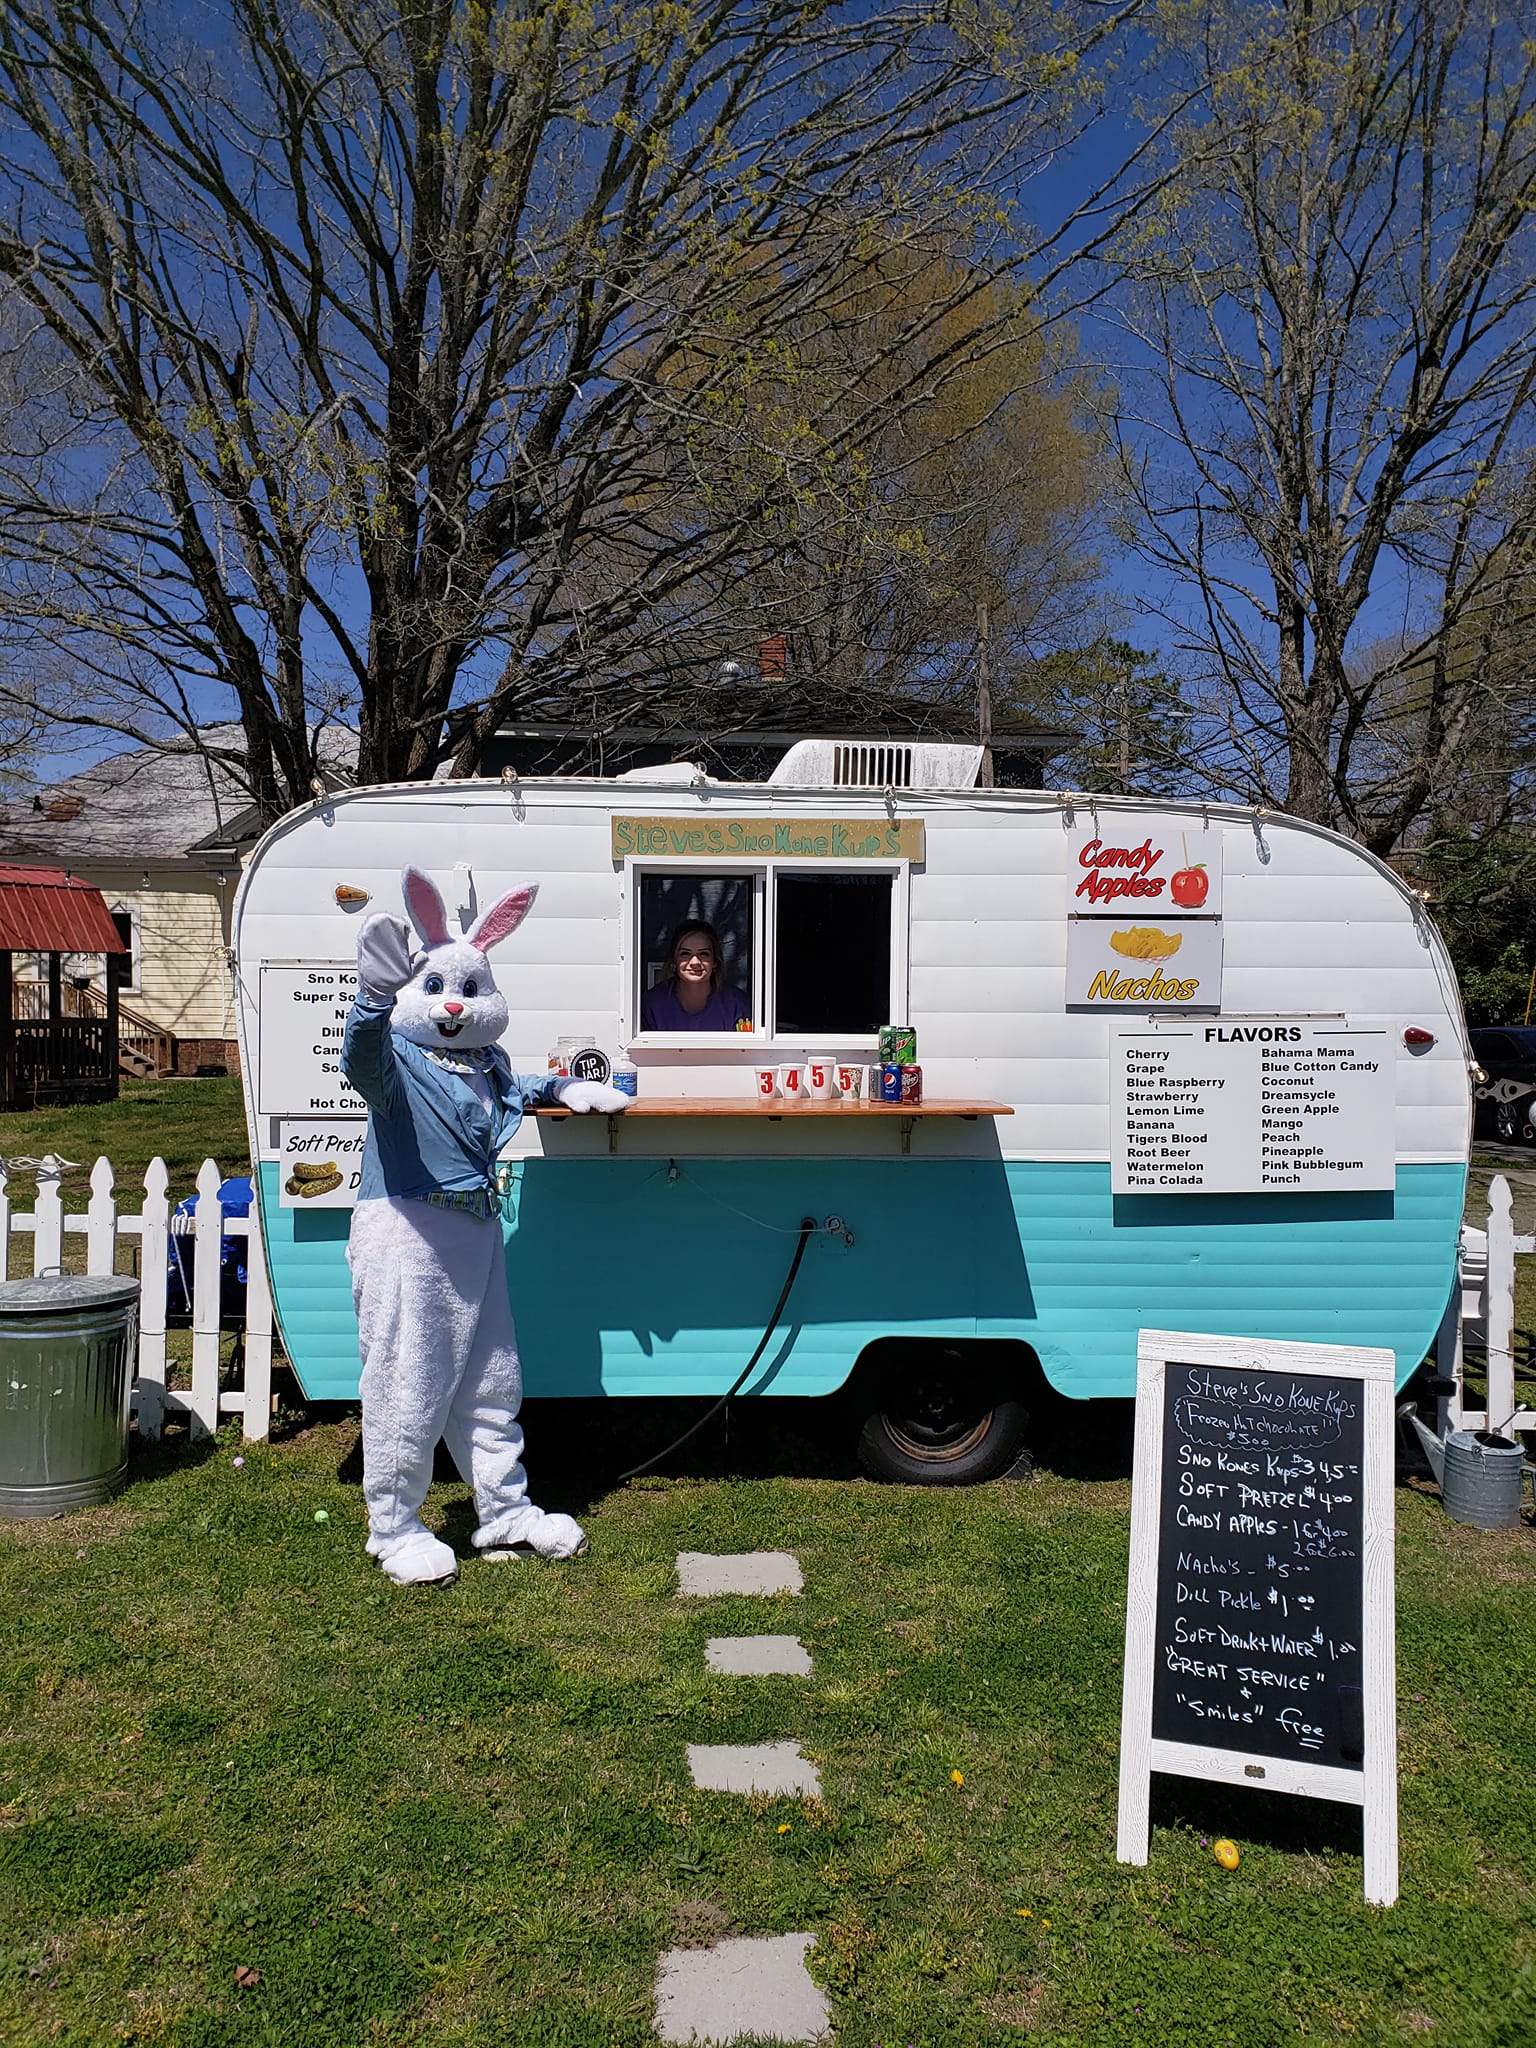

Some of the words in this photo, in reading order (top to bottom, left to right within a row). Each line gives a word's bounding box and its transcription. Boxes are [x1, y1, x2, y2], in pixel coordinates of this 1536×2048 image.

[615, 821, 725, 855] Steve's
[1078, 838, 1164, 875] Candy
[1075, 869, 1166, 905] Apples
[308, 974, 334, 984] Sno
[339, 974, 358, 984] Ko
[1087, 967, 1199, 1001] Nachos
[293, 991, 335, 1003] Super
[338, 992, 356, 1002] So
[322, 1027, 344, 1037] Dill
[1205, 1027, 1302, 1043] FLAVORS
[1127, 1050, 1170, 1061] Cherry
[1262, 1048, 1313, 1058] Bahama
[1317, 1047, 1355, 1057] Mama
[579, 1058, 597, 1071] TIP
[1127, 1064, 1165, 1075] Grape
[1262, 1062, 1290, 1072] Blue
[1294, 1062, 1336, 1072] Cotton
[1340, 1061, 1379, 1073] Candy
[582, 1066, 605, 1081] JAR!
[812, 1065, 824, 1088] 5
[761, 1072, 773, 1094] 3
[786, 1069, 799, 1092] 4
[839, 1069, 851, 1091] 5
[1127, 1078, 1155, 1088] Blue
[1159, 1078, 1226, 1089] Raspberry
[1262, 1076, 1315, 1086] Coconut
[1127, 1092, 1199, 1103] Strawberry
[1262, 1090, 1336, 1101] Dreamsycle
[310, 1098, 335, 1109] Hot
[340, 1098, 366, 1109] Cho
[1127, 1106, 1169, 1116] Lemon
[1173, 1106, 1205, 1116] Lime
[1262, 1105, 1299, 1114] Green
[1303, 1104, 1340, 1115] Apple
[1127, 1120, 1175, 1130] Banana
[1262, 1119, 1303, 1130] Mango
[1127, 1134, 1167, 1145] Tigers
[1171, 1134, 1208, 1144] Blood
[1262, 1132, 1300, 1142] Peach
[286, 1135, 324, 1153] Soft
[325, 1134, 366, 1153] Pretz
[1127, 1148, 1157, 1158] Root
[1161, 1148, 1191, 1158] Beer
[1262, 1146, 1324, 1157] Pineapple
[1127, 1162, 1204, 1172] Watermelon
[1262, 1160, 1290, 1170] Pink
[1293, 1160, 1364, 1171] Bubblegum
[1128, 1175, 1155, 1186] Pina
[1159, 1175, 1203, 1185] Colada
[1262, 1174, 1301, 1184] Punch
[1186, 1369, 1248, 1400] Steve's
[1293, 1541, 1305, 1557] 2
